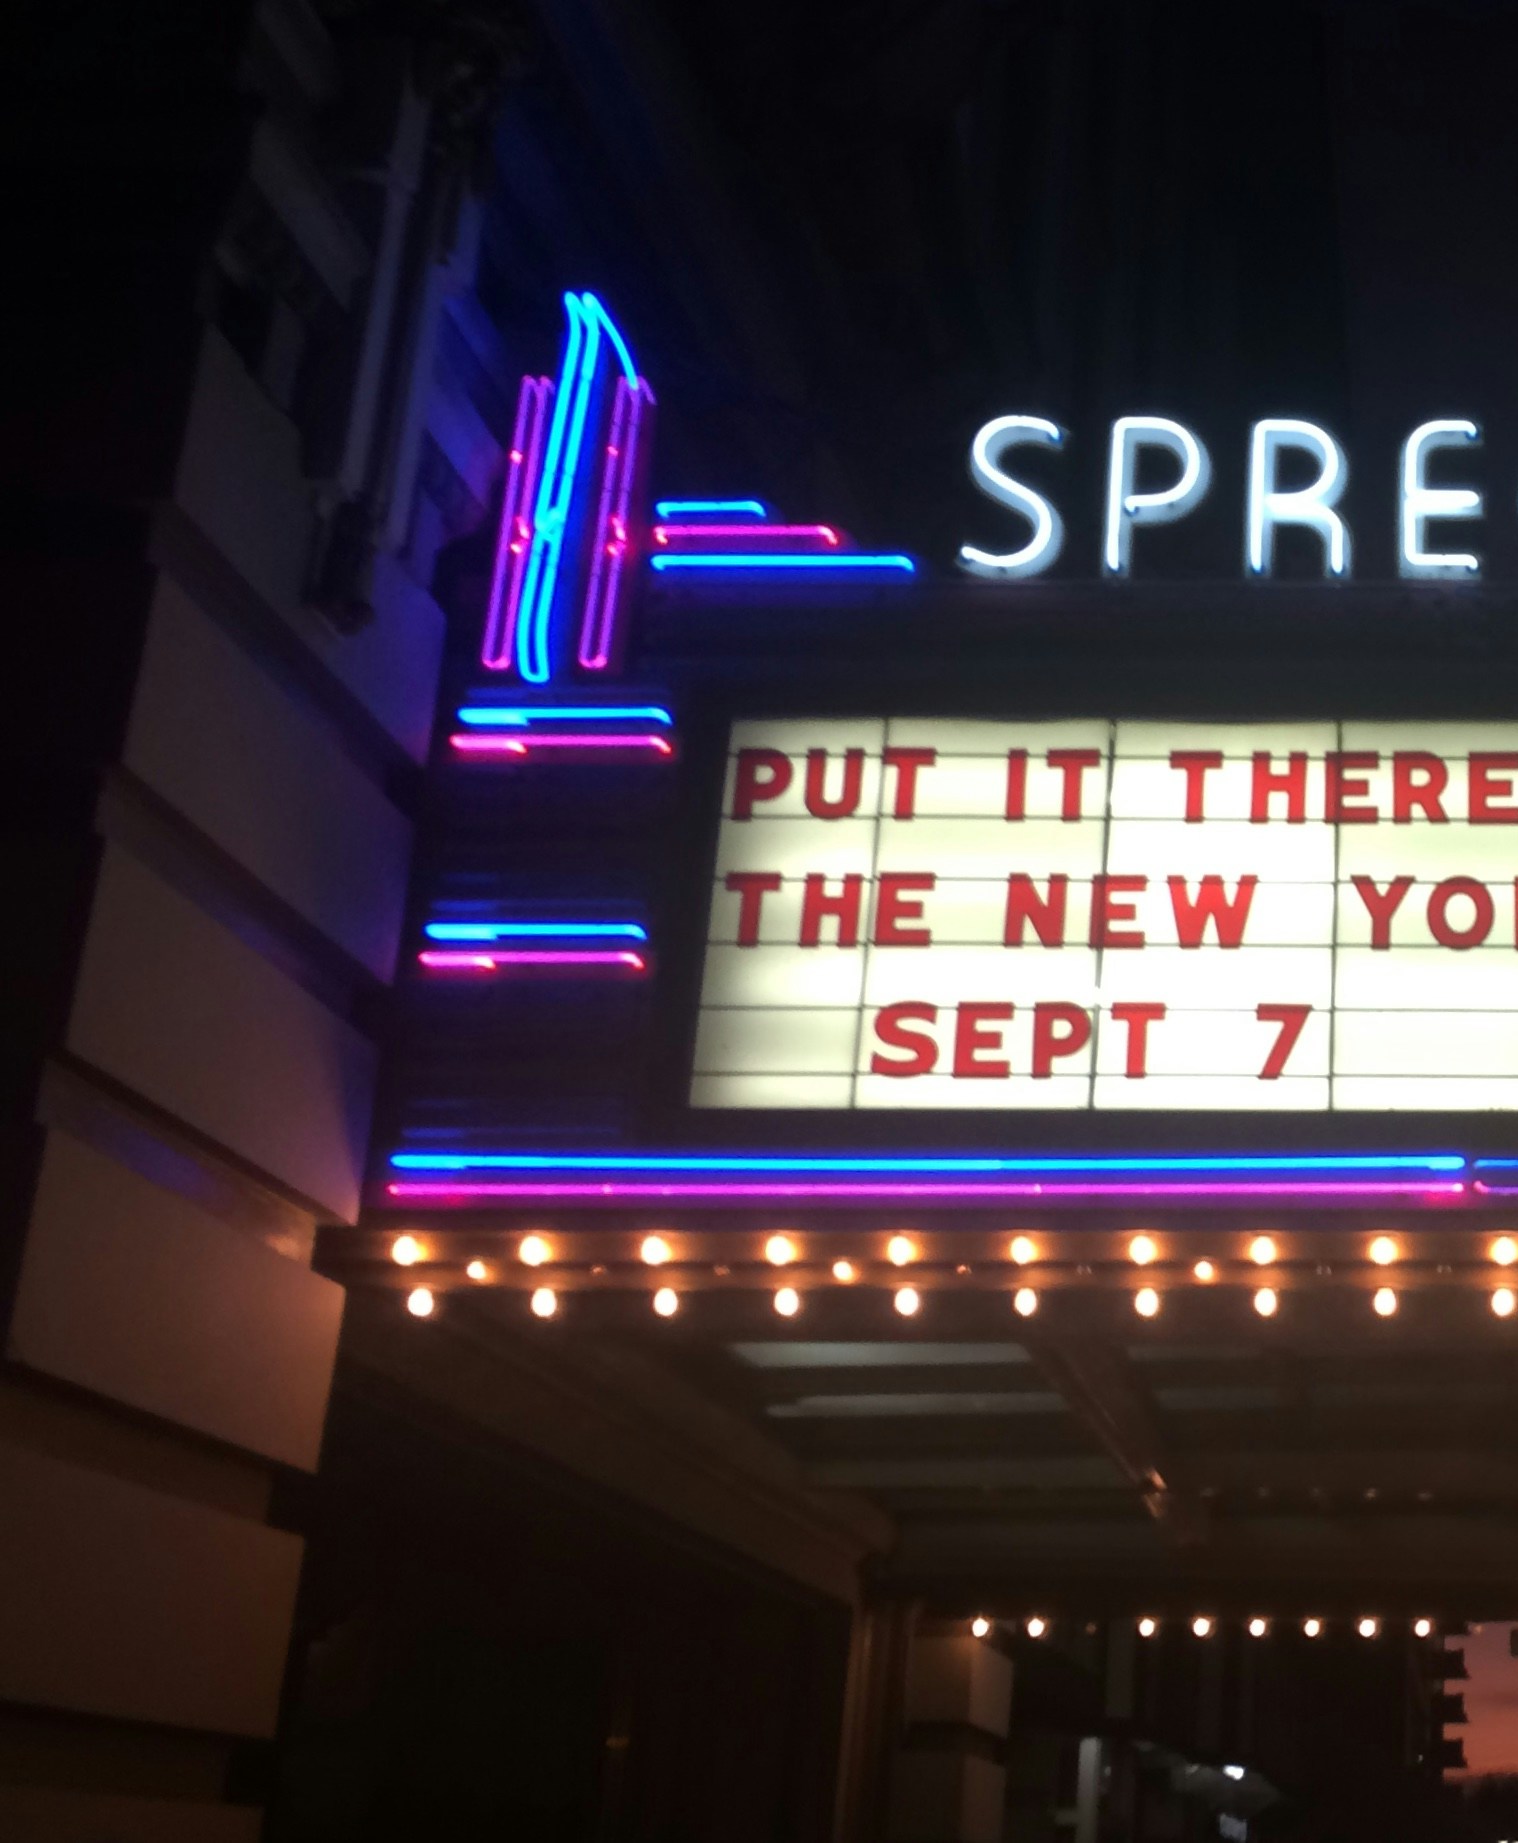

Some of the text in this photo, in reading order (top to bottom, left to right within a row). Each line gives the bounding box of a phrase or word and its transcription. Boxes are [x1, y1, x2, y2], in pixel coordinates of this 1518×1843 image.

[731, 747, 937, 821] PUT
[1004, 748, 1101, 822] IT
[725, 872, 937, 949] THE
[1003, 873, 1259, 950] NEW
[870, 1001, 1167, 1080] SEPT
[1256, 1003, 1314, 1080] 7
